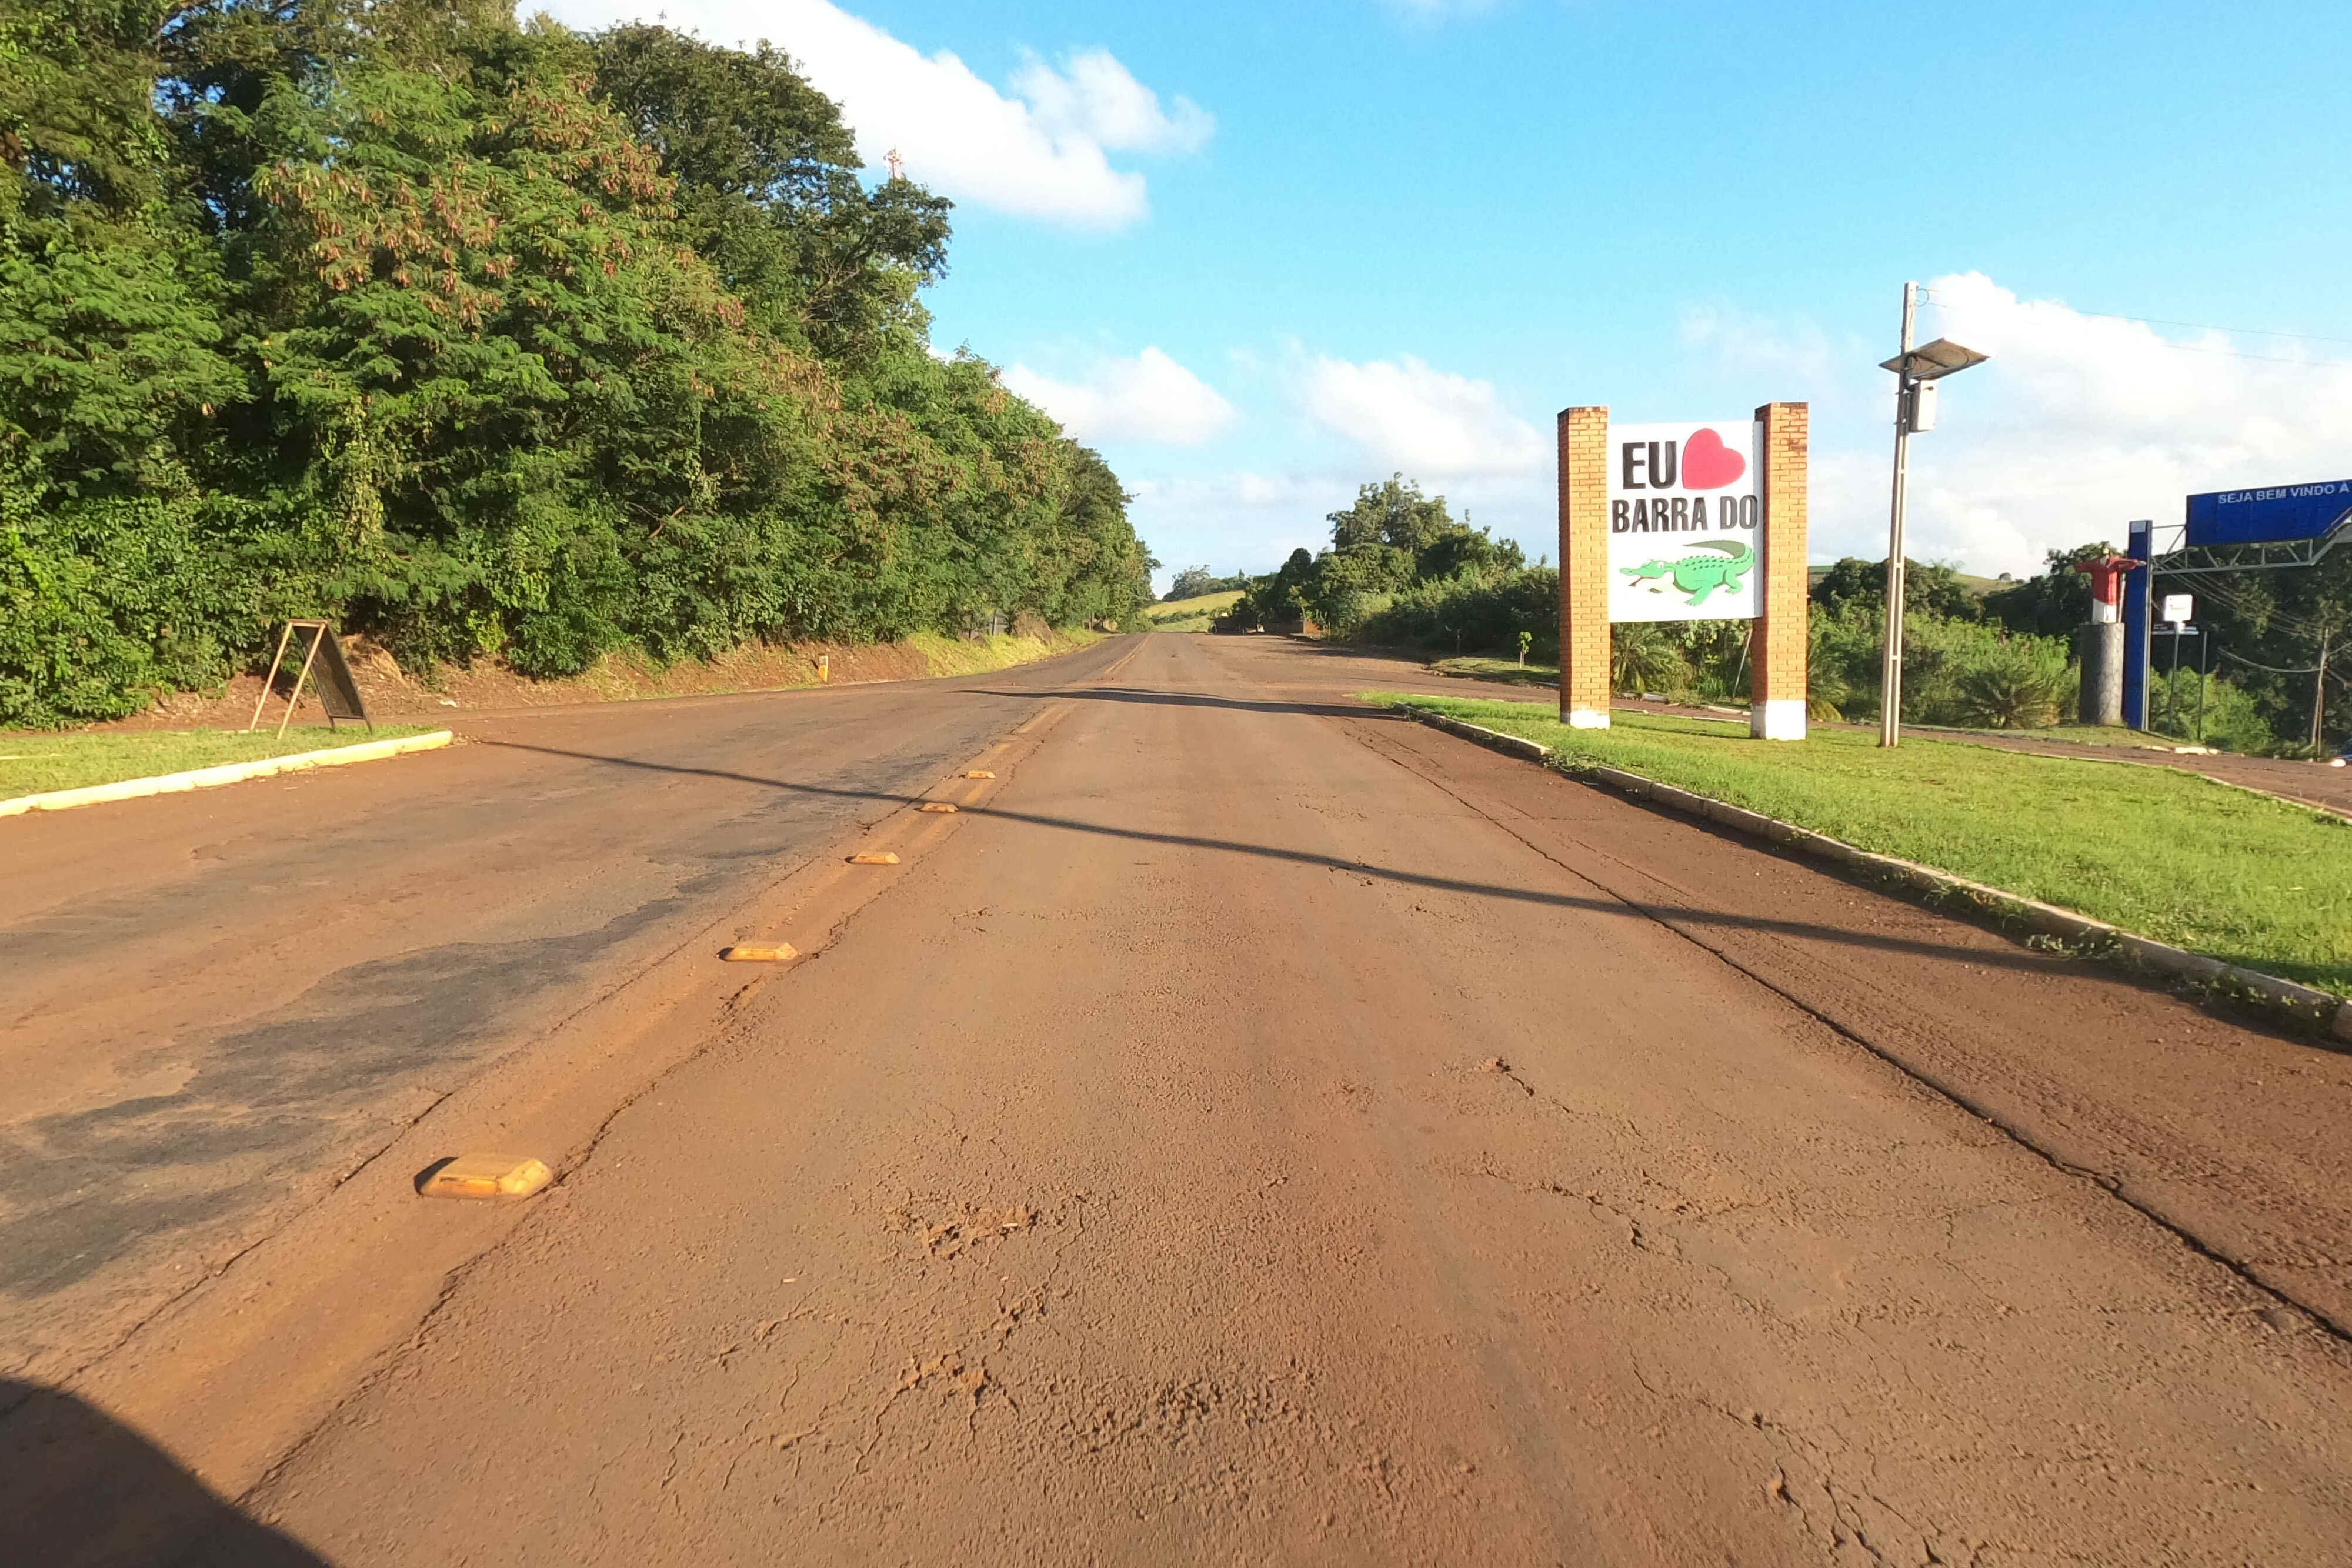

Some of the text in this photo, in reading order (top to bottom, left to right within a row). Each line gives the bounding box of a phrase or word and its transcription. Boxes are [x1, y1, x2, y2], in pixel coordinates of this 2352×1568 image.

[1622, 441, 1677, 489] EU
[2218, 492, 2253, 504] SEJA
[2256, 489, 2286, 501] BEM
[2290, 484, 2334, 497] VINDO
[1612, 495, 1758, 533] BARRA DO
